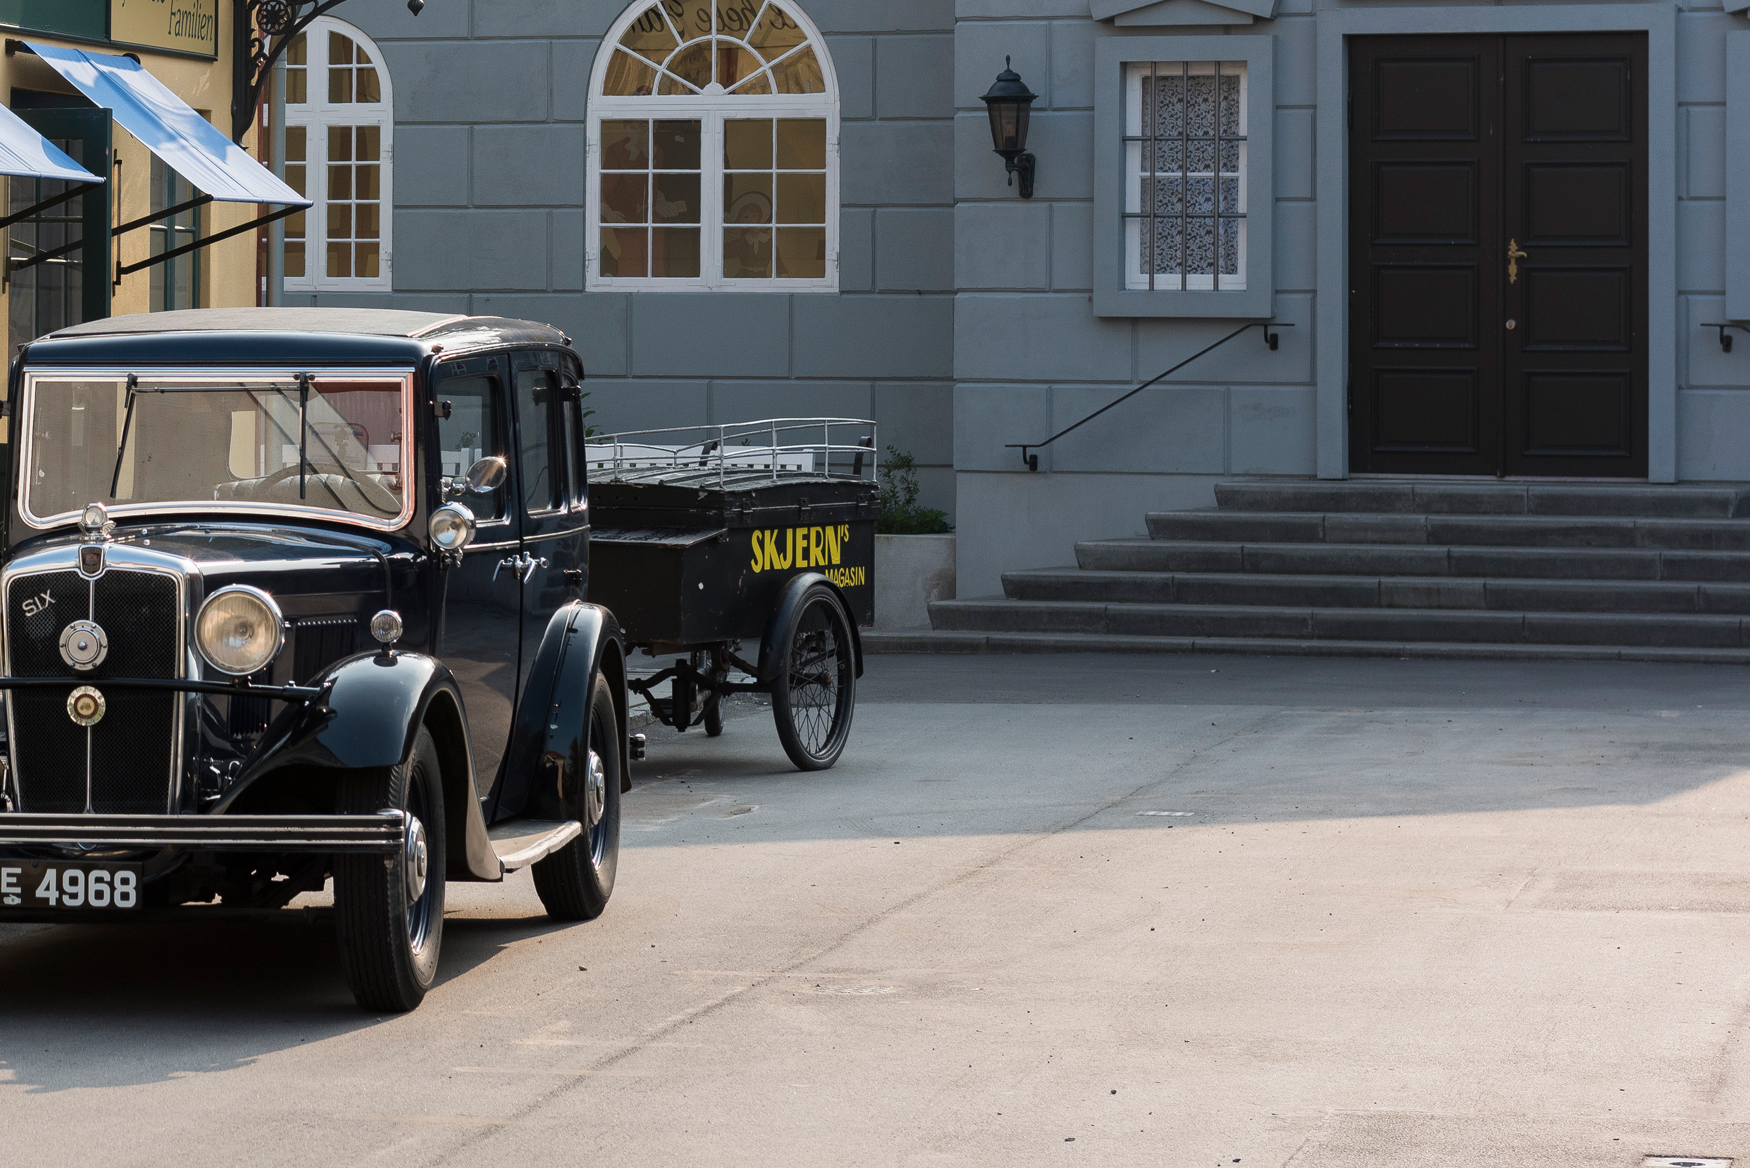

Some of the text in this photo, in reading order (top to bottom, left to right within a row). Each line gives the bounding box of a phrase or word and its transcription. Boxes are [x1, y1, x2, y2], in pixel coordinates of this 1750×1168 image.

[22, 589, 56, 617] SIX
[1, 867, 137, 908] E 4968
